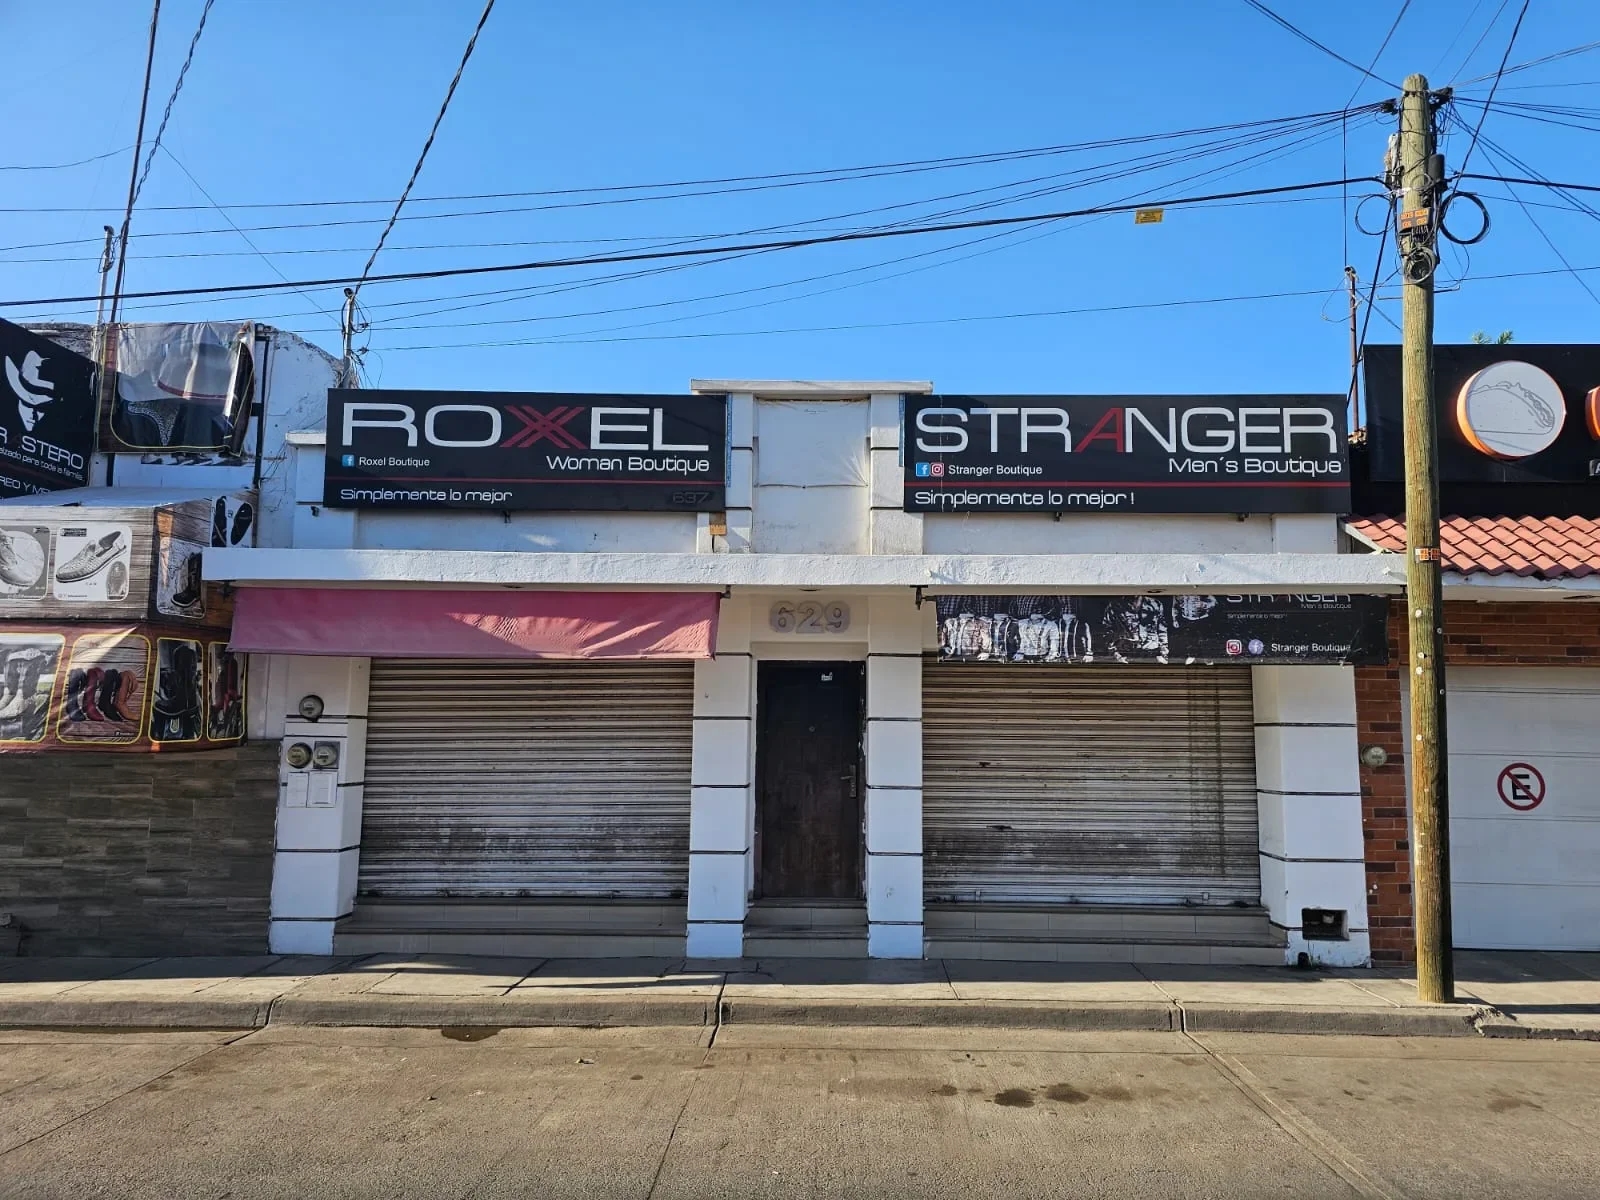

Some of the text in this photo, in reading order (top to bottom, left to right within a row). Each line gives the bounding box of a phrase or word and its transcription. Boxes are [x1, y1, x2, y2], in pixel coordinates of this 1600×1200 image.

[342, 402, 709, 451] ROXEL
[916, 407, 1338, 453] STRANGER
[359, 456, 430, 468] Roxel Boutique
[546, 455, 710, 476] Woman Boutique
[948, 465, 1043, 476] Stranger Boutique
[1244, 456, 1342, 478] Boutique
[340, 488, 513, 504] Simplemente lo mejor
[672, 491, 709, 504] 637
[915, 489, 1044, 508] Simplemente
[1048, 489, 1063, 505] lo
[1068, 489, 1127, 509] mejor
[769, 600, 850, 634] 629
[1271, 643, 1351, 655] Stranger Boutique
